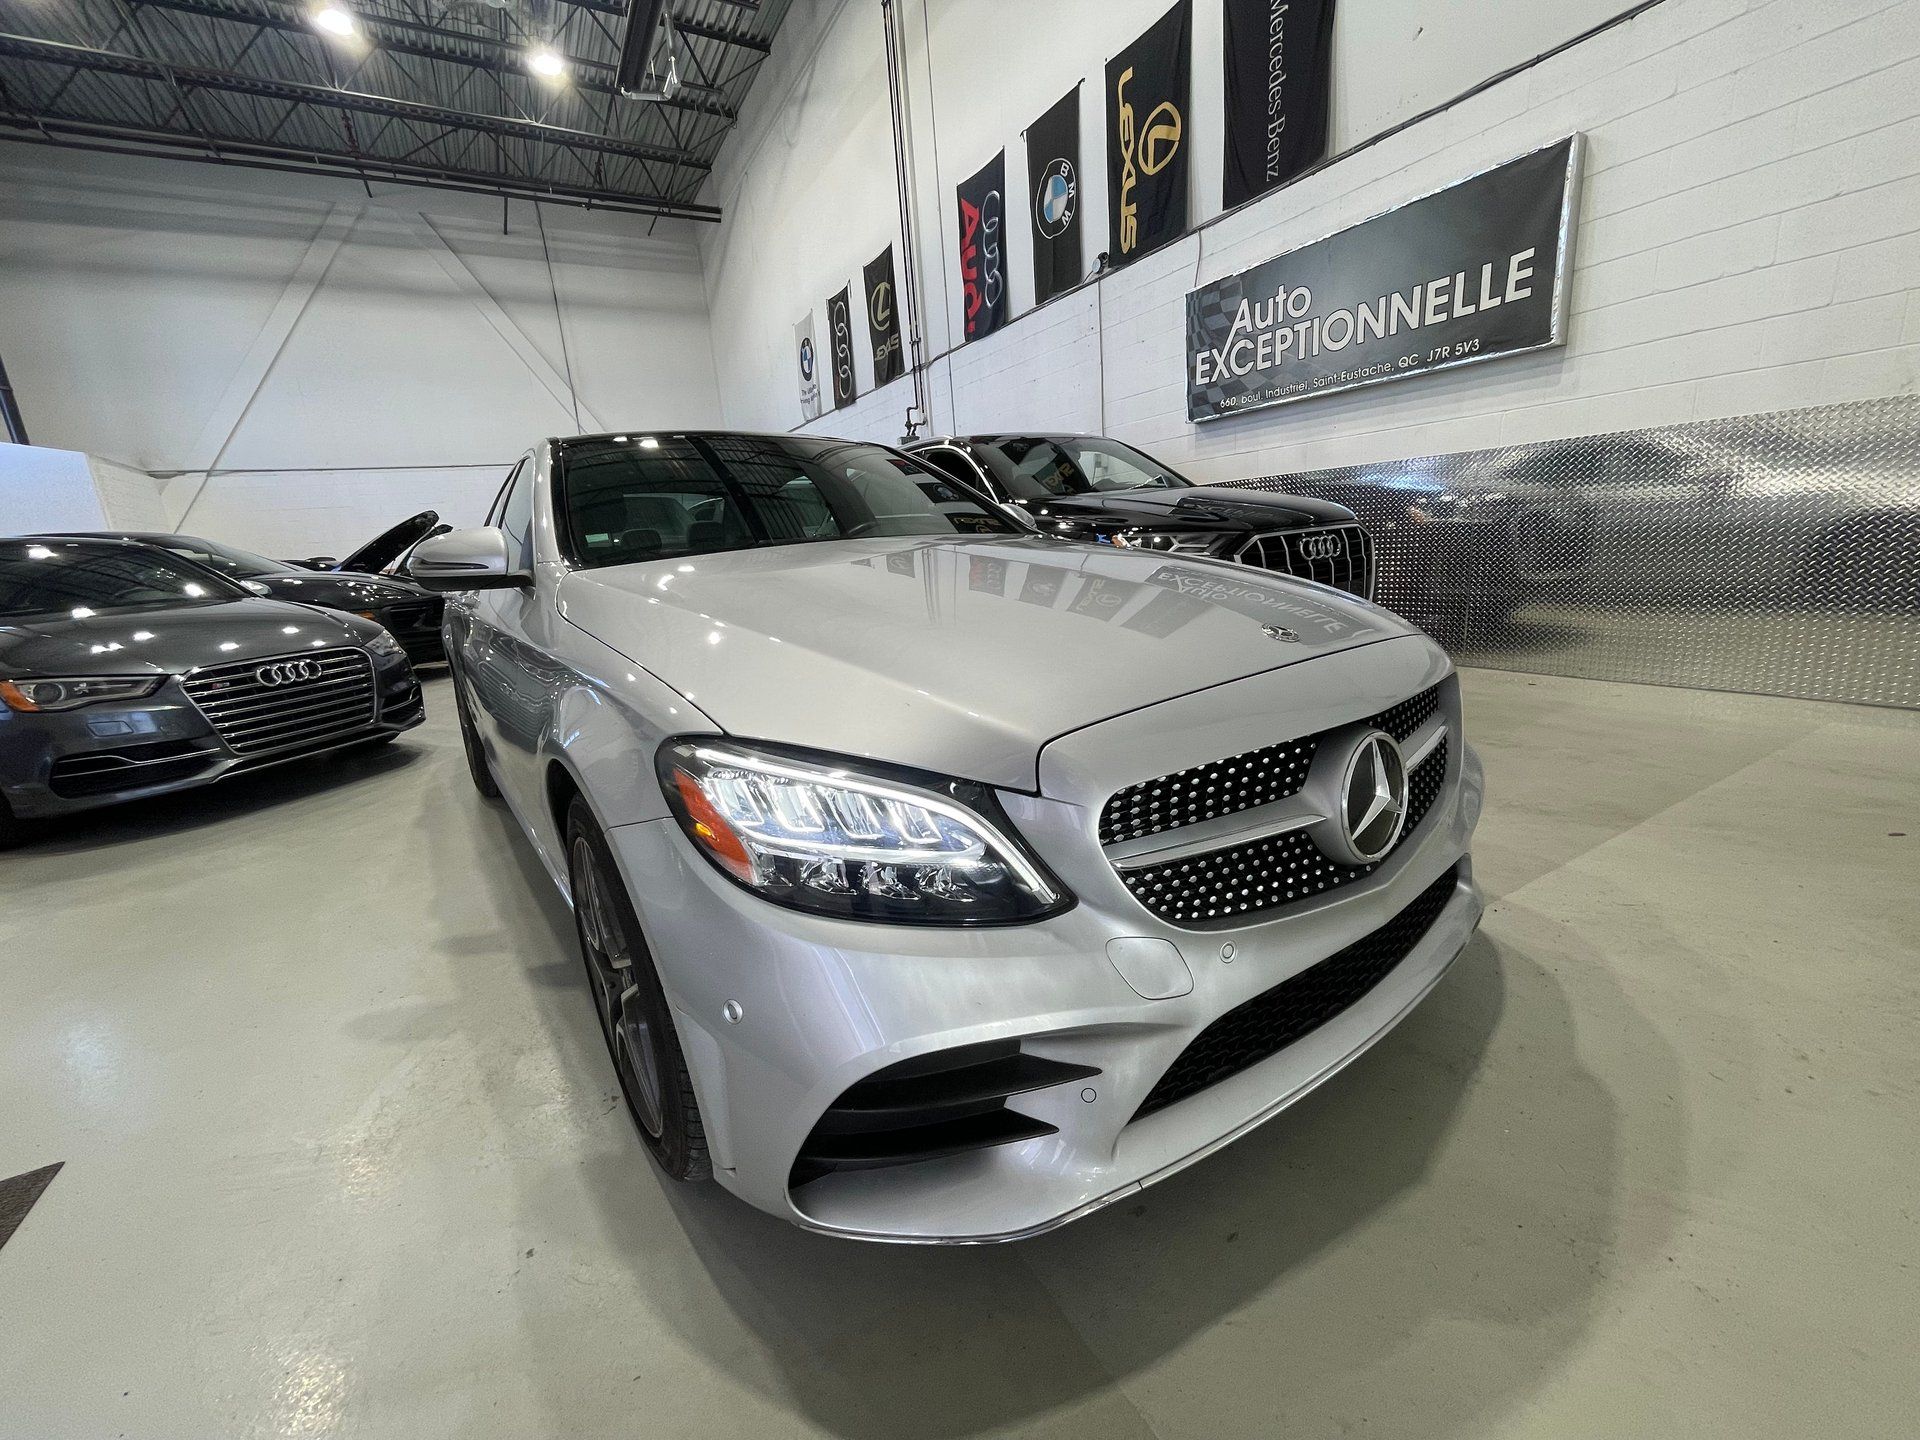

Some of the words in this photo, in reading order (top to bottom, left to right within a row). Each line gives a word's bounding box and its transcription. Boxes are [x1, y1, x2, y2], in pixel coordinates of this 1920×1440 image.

[1117, 66, 1137, 254] LEXUS
[1266, 0, 1288, 182] Mercedes-Benz
[1195, 247, 1536, 386] EXCEPTIONNELLE
[1223, 284, 1313, 341] Auto
[1241, 391, 1263, 404] boul.
[1313, 361, 1395, 388] Saint-Eustache,
[1398, 353, 1419, 369] QC
[1426, 347, 1451, 362] J7R
[1454, 338, 1481, 356] 5V3
